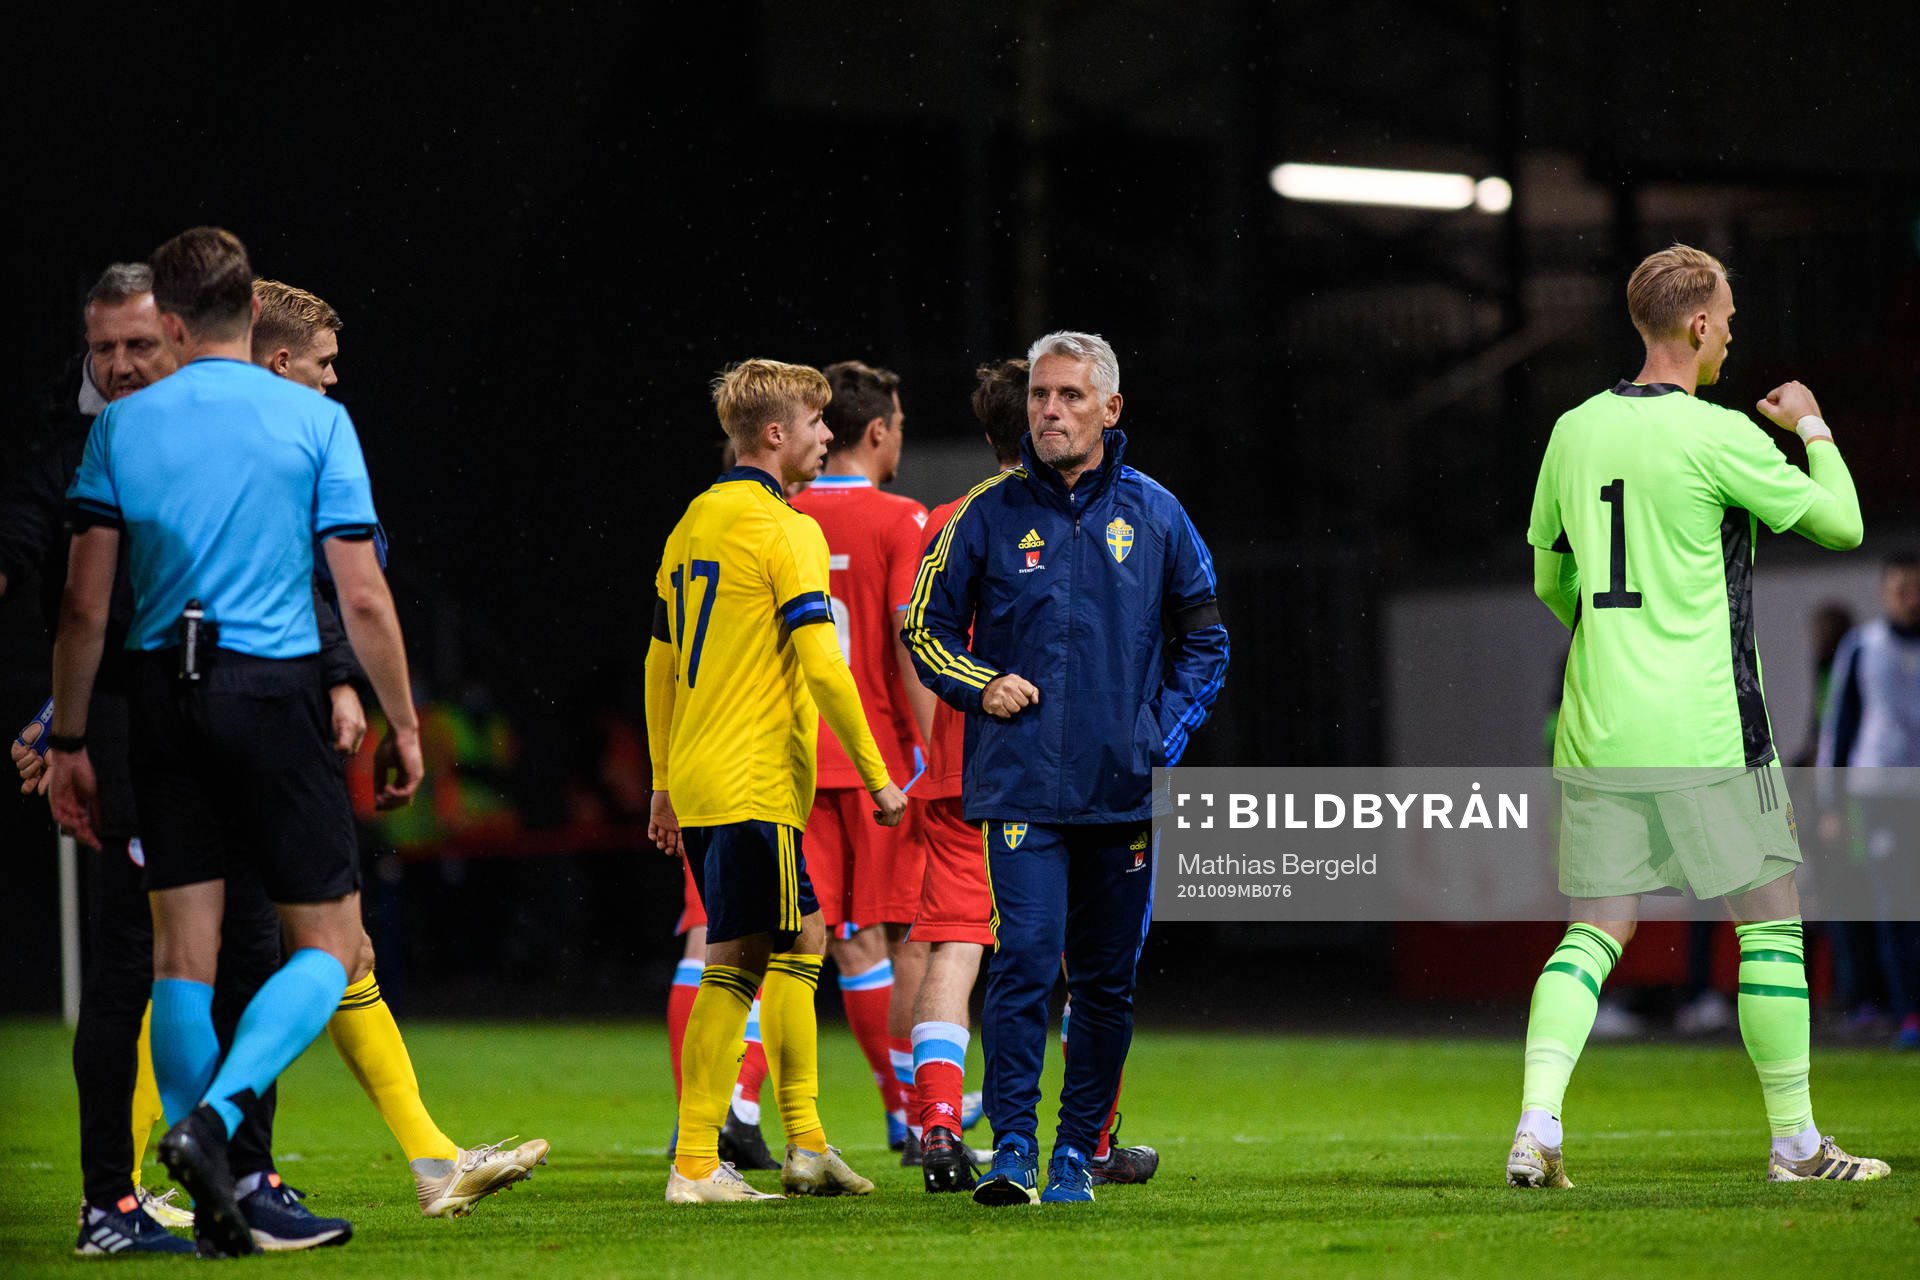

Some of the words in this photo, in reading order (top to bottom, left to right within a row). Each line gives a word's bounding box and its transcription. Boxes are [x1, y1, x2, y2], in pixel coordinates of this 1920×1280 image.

[1018, 540, 1045, 549] adidas
[1592, 478, 1642, 609] 1
[670, 559, 720, 688] 17
